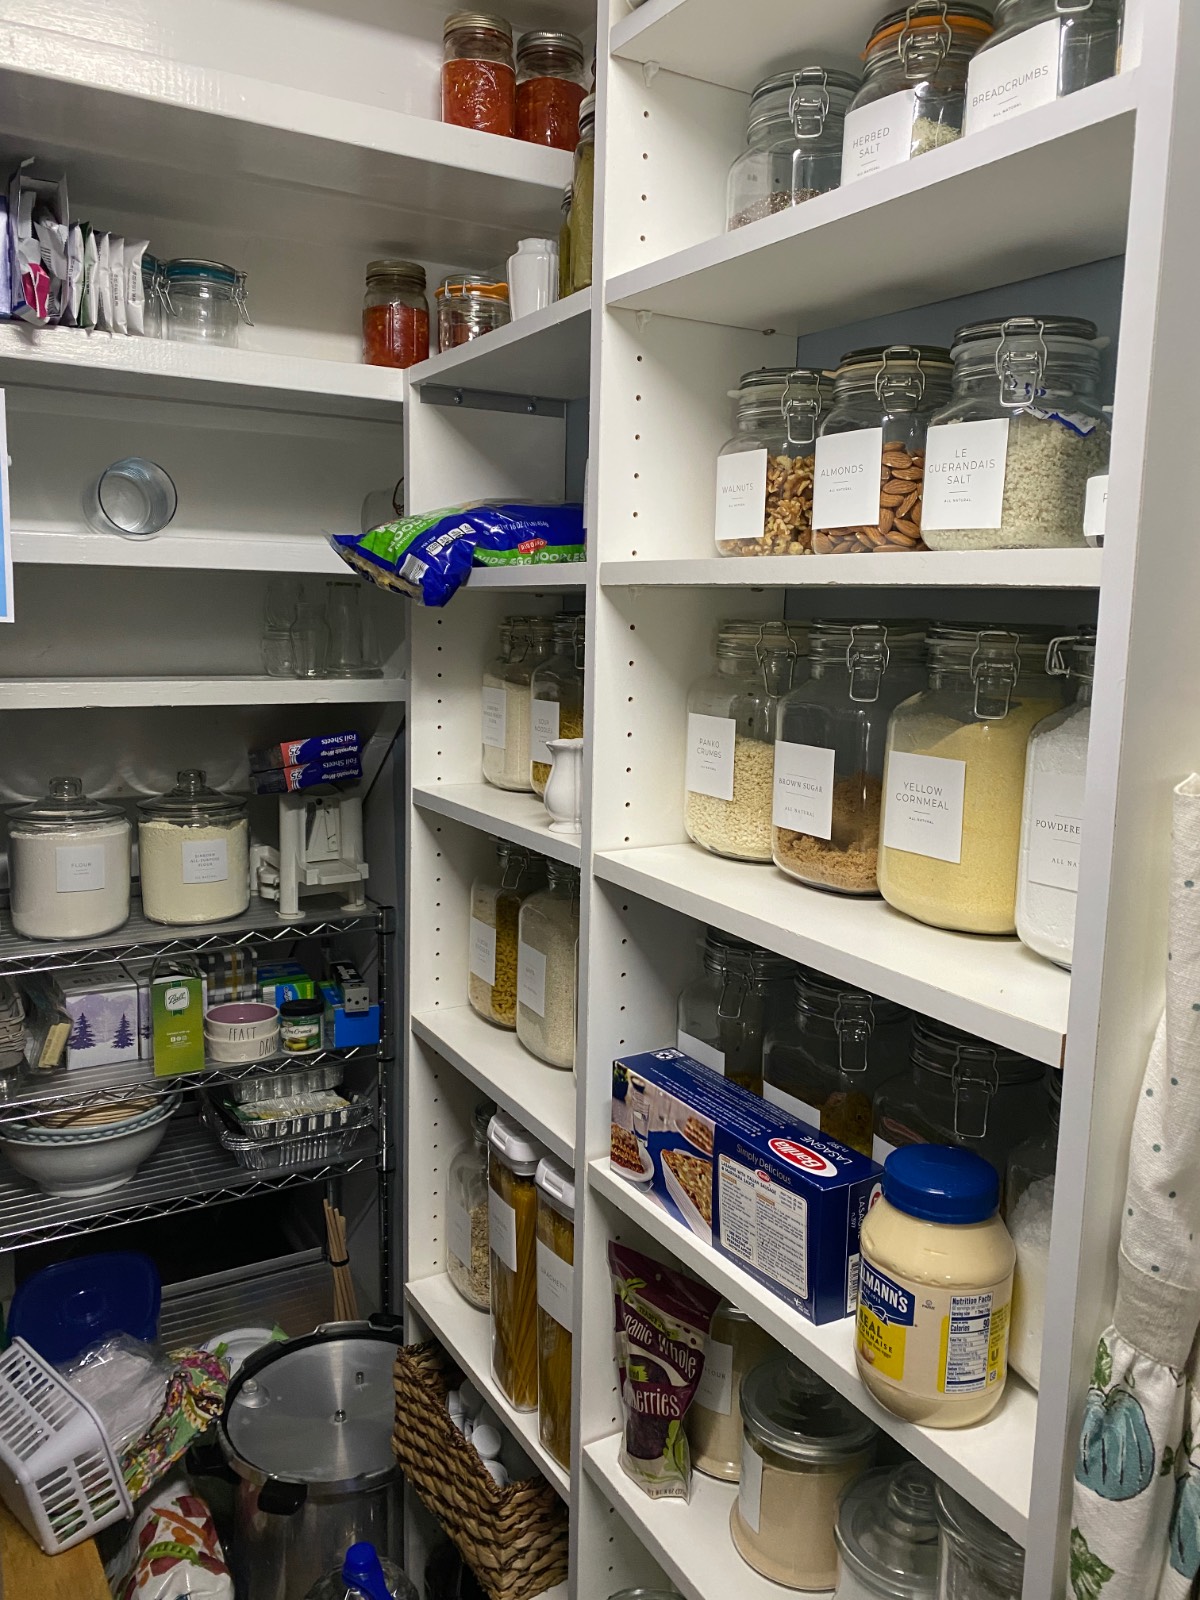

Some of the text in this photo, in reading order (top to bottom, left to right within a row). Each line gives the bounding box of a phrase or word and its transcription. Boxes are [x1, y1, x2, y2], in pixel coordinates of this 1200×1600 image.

[972, 65, 1048, 107] BREADCRUMBS
[852, 127, 890, 148] HERBED
[859, 143, 880, 158] SALT
[955, 448, 967, 458] LE
[820, 464, 864, 478] ALMONDS
[928, 459, 996, 474] GUERANDAIS
[947, 474, 972, 484] SALT
[722, 483, 754, 494] WALNUTS
[322, 736, 343, 745] Sheets
[700, 738, 720, 748] PANKO
[289, 747, 300, 756] 25
[696, 747, 722, 759] CRUMBS
[323, 760, 344, 768] Sheets
[291, 772, 302, 780] 25
[778, 777, 823, 793] BROWN SUGAR
[903, 782, 943, 796] YELLOW
[896, 793, 949, 810] CORNMEAL
[794, 809, 815, 817] NATURAL
[1036, 820, 1080, 835] POWDERE
[168, 992, 186, 1005] Ball
[774, 1140, 822, 1169] Barilla
[800, 1136, 852, 1165] LASAGNE
[736, 1144, 758, 1165] Simply
[759, 1160, 792, 1185] Delicious
[760, 1182, 777, 1194] SAUSAGE
[863, 1268, 908, 1313] LMANN'S
[952, 1297, 977, 1305] Nutrition
[983, 1319, 989, 1328] 90
[624, 1312, 696, 1379] ganic Whole
[632, 1388, 680, 1416] erries
